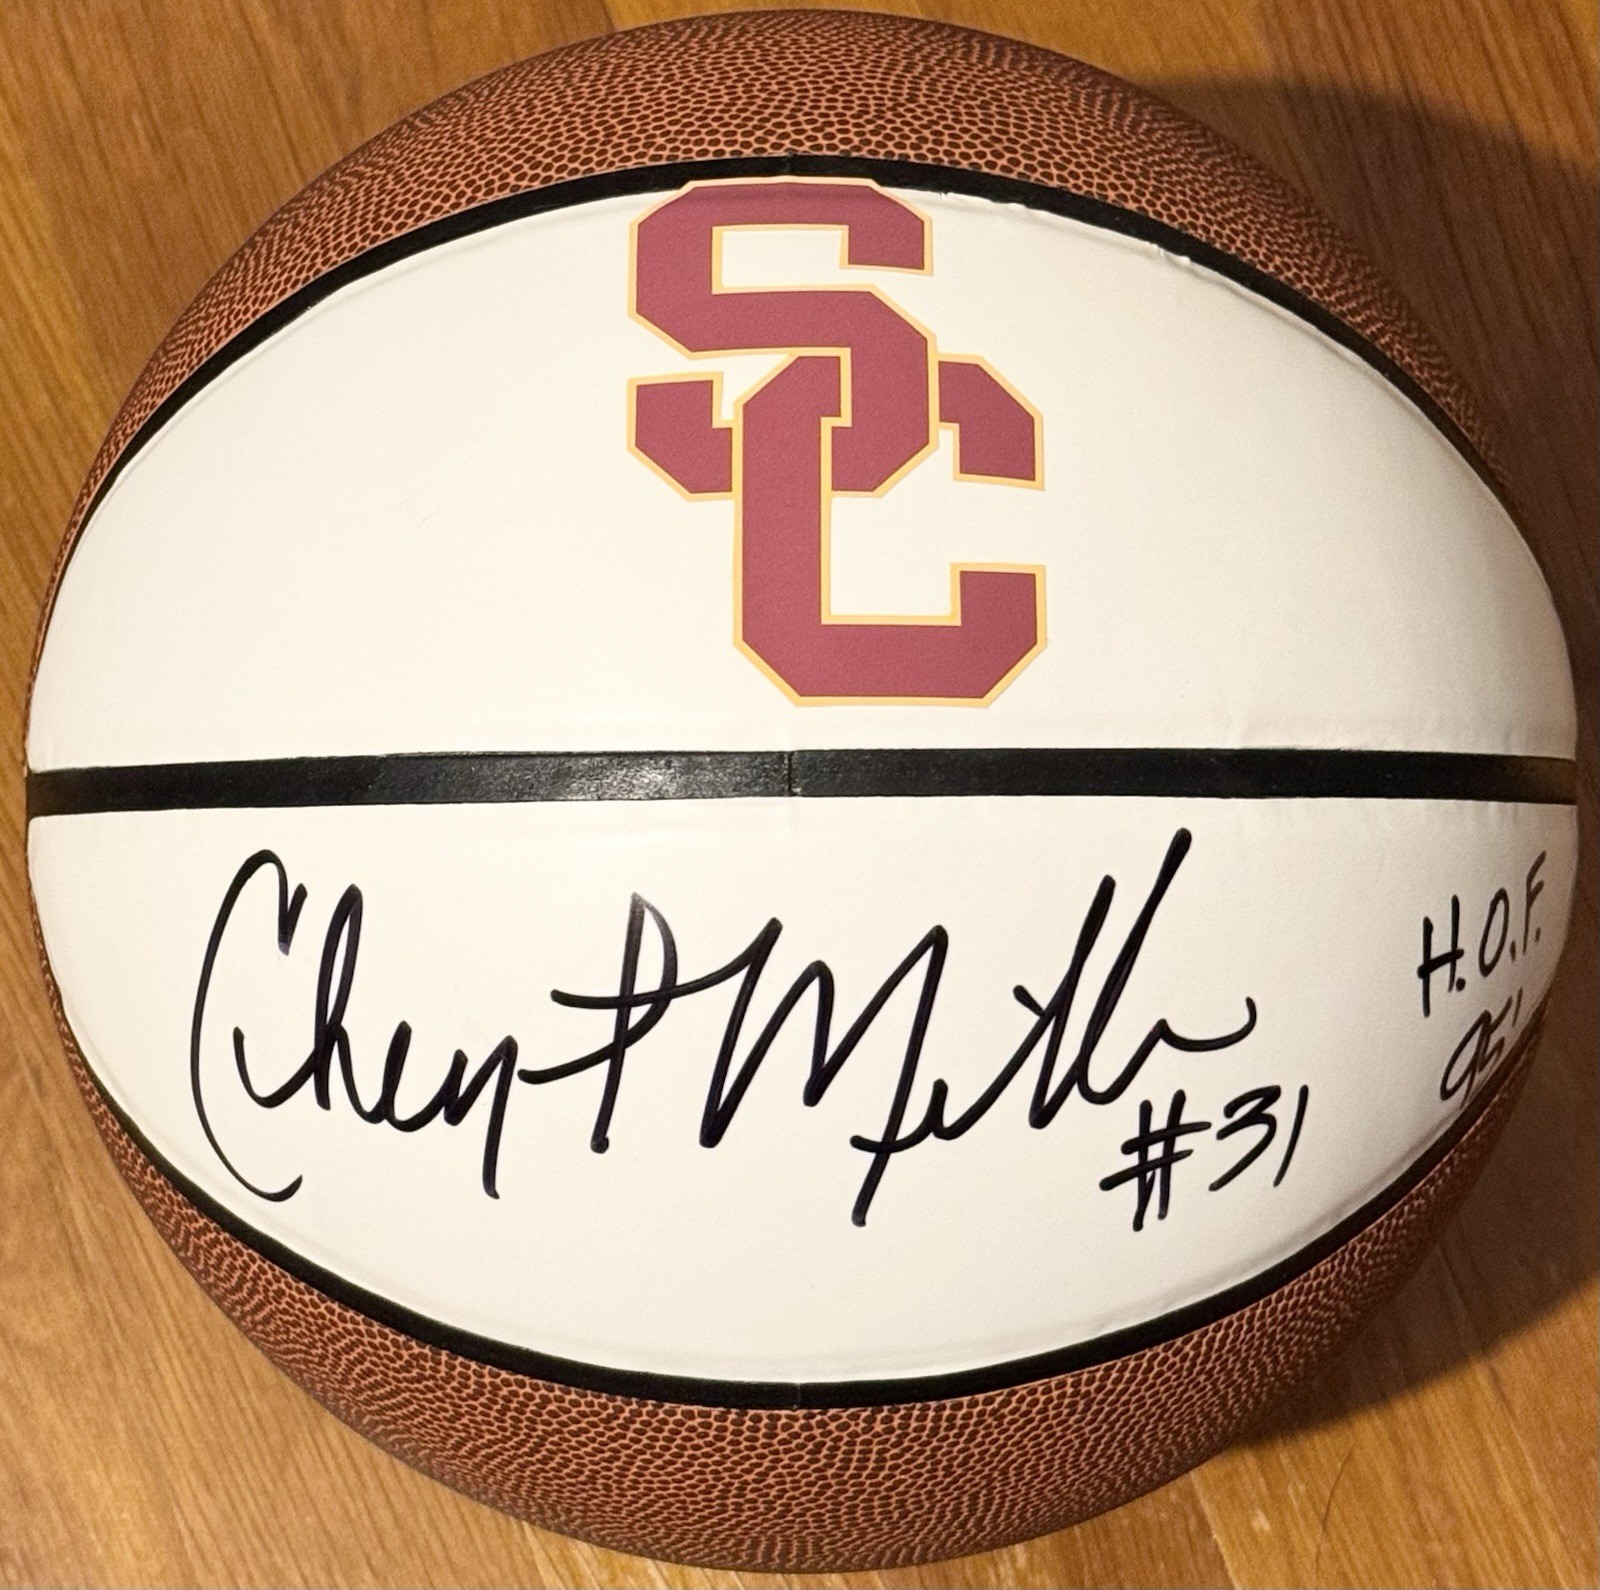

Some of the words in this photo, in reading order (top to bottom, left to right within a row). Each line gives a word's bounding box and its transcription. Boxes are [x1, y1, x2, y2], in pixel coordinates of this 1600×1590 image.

[627, 175, 1048, 709] SC
[1416, 850, 1547, 1018] H.O.F.
[1099, 1084, 1309, 1232] #31
